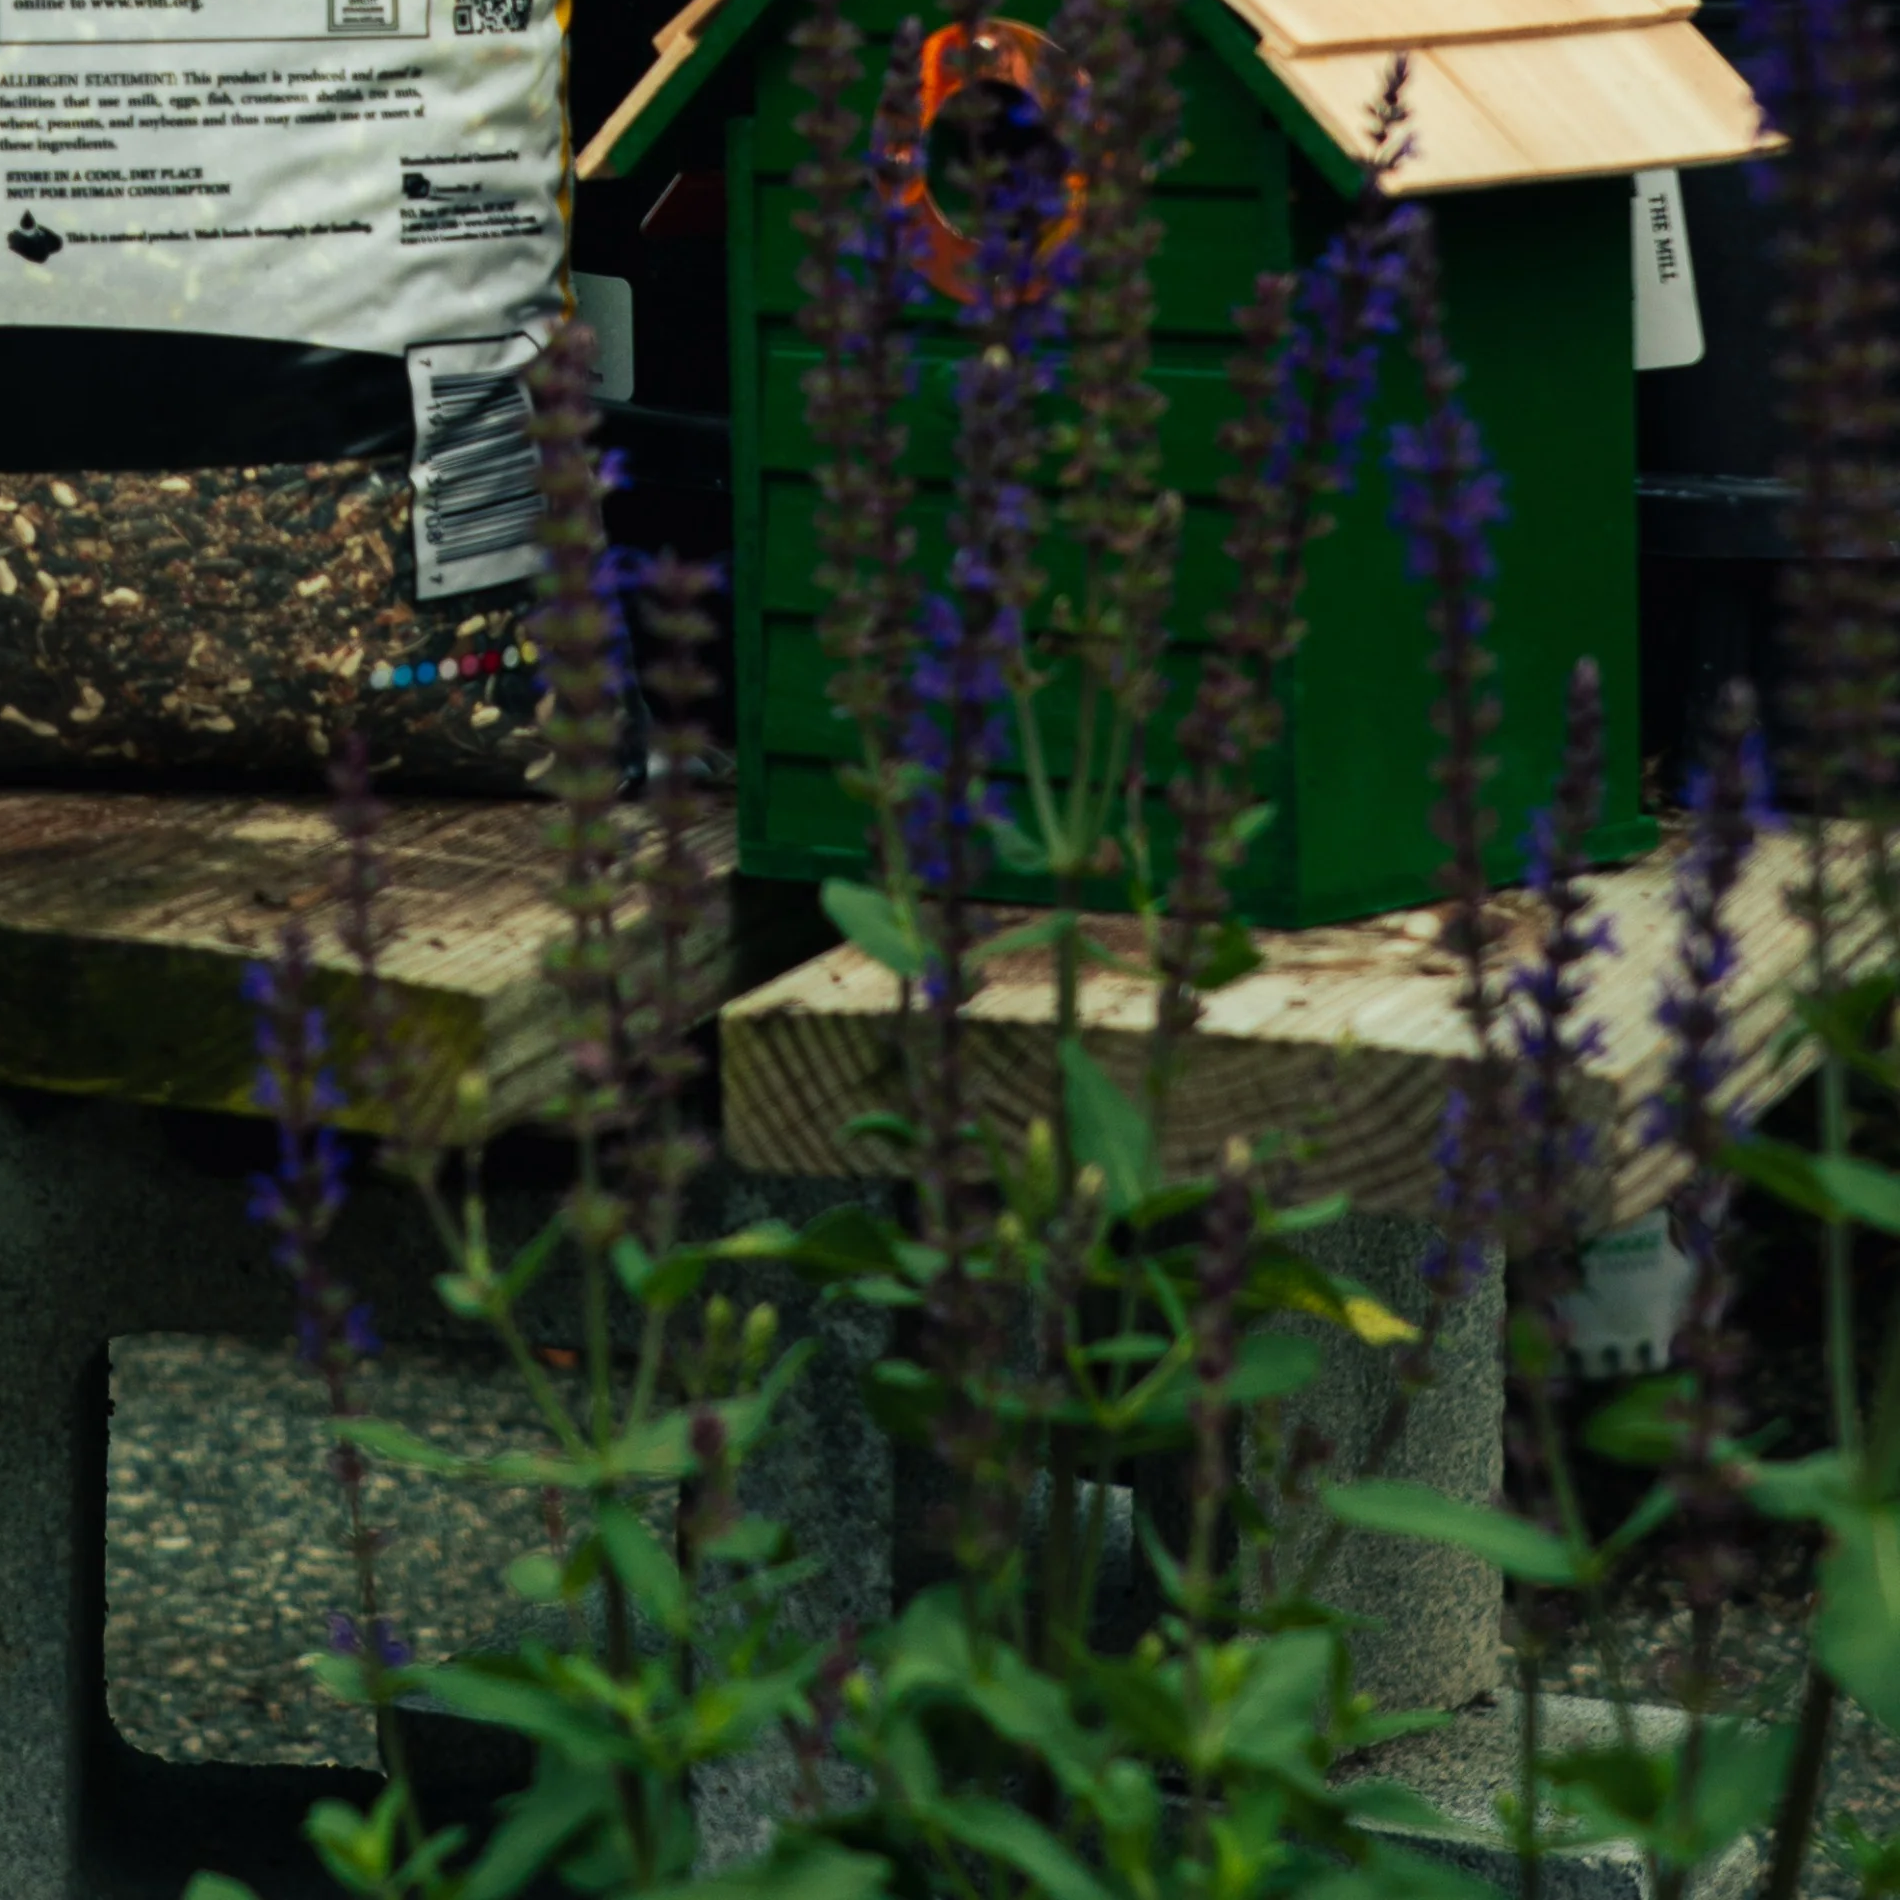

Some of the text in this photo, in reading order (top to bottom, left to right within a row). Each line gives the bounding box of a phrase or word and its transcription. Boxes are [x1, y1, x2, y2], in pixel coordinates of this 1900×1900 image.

[0, 73, 78, 88] ALLERGEN
[183, 71, 212, 85] This
[217, 71, 266, 88] product
[288, 69, 346, 86] produced
[0, 94, 90, 109] facilities that
[109, 112, 259, 131] and soybeans and thus
[0, 137, 117, 154] these ingredients.
[161, 167, 202, 180] PLACE
[128, 183, 231, 197] CONSUMPTION
[1648, 193, 1679, 284] THE MILL
